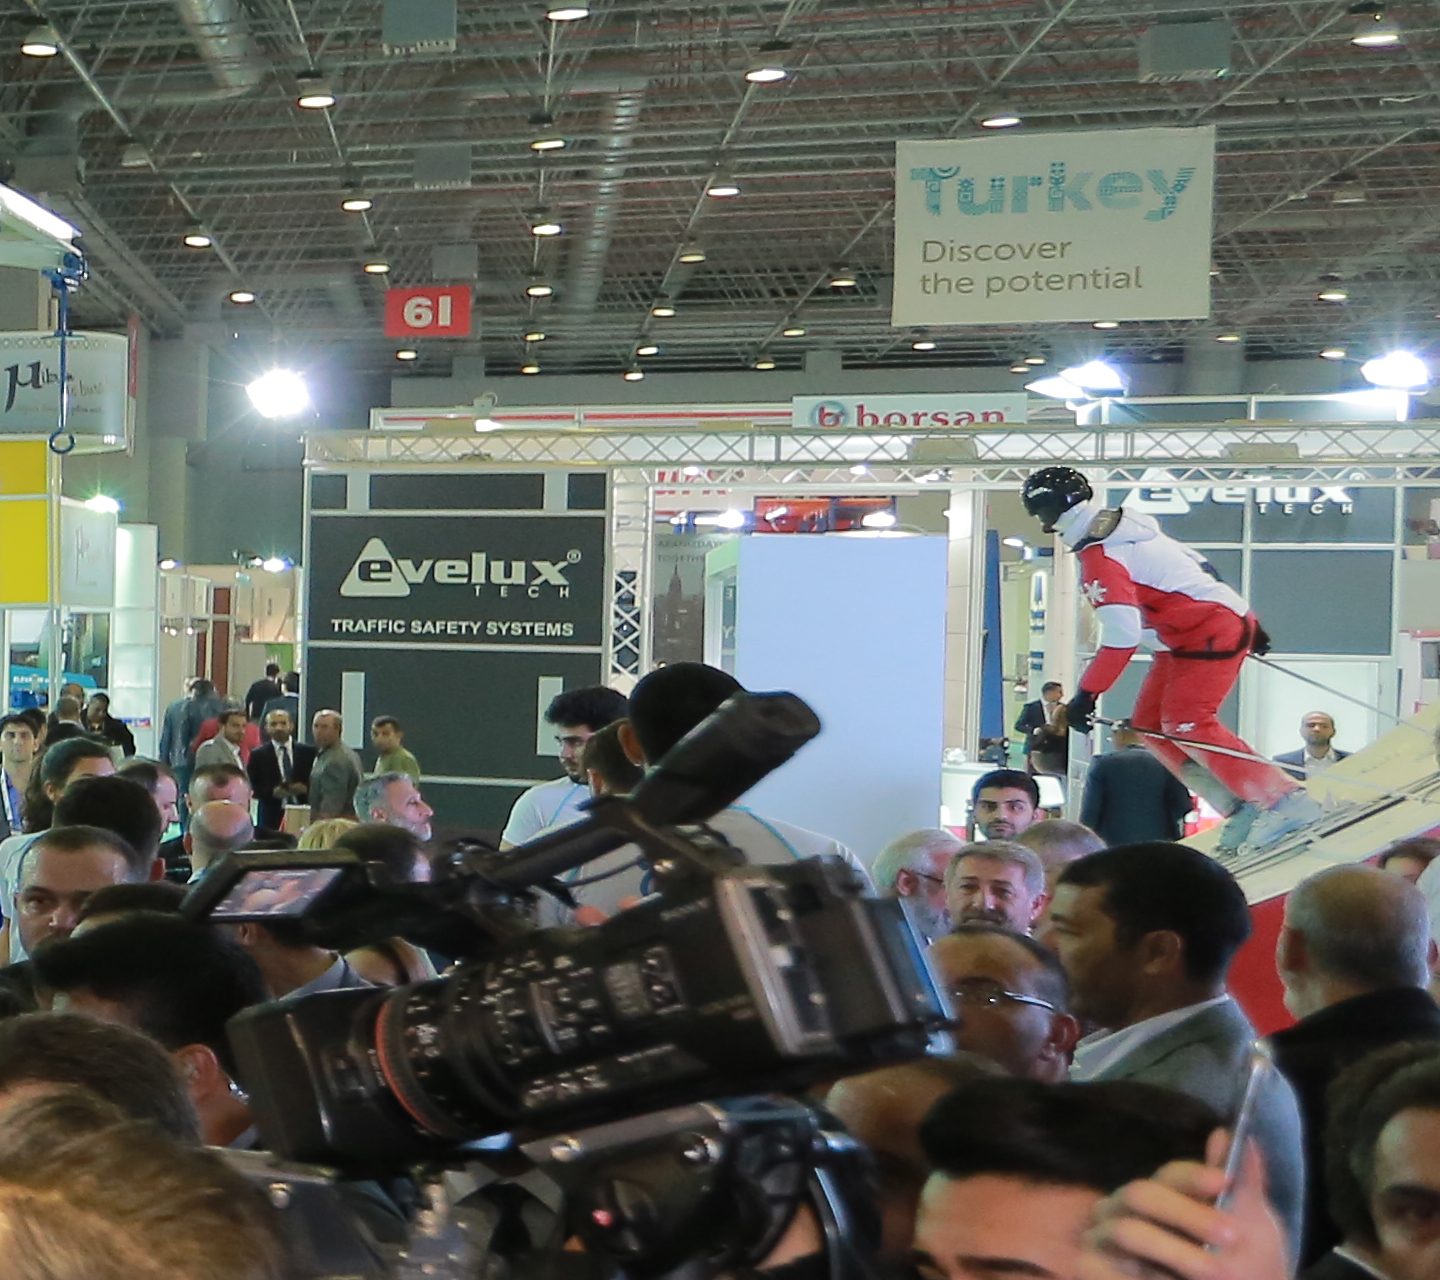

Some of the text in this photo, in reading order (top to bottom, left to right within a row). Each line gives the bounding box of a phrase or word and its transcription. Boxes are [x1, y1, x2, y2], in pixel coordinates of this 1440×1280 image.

[910, 161, 1197, 222] Turkey
[921, 238, 1073, 264] Discover
[920, 266, 1144, 299] the potential
[856, 404, 1005, 427] borsan
[1257, 503, 1353, 515] TECH
[357, 551, 570, 586] evelux
[474, 585, 570, 599] TECH
[331, 619, 574, 637] TRAFFIC SAFETY SYSTEMS
